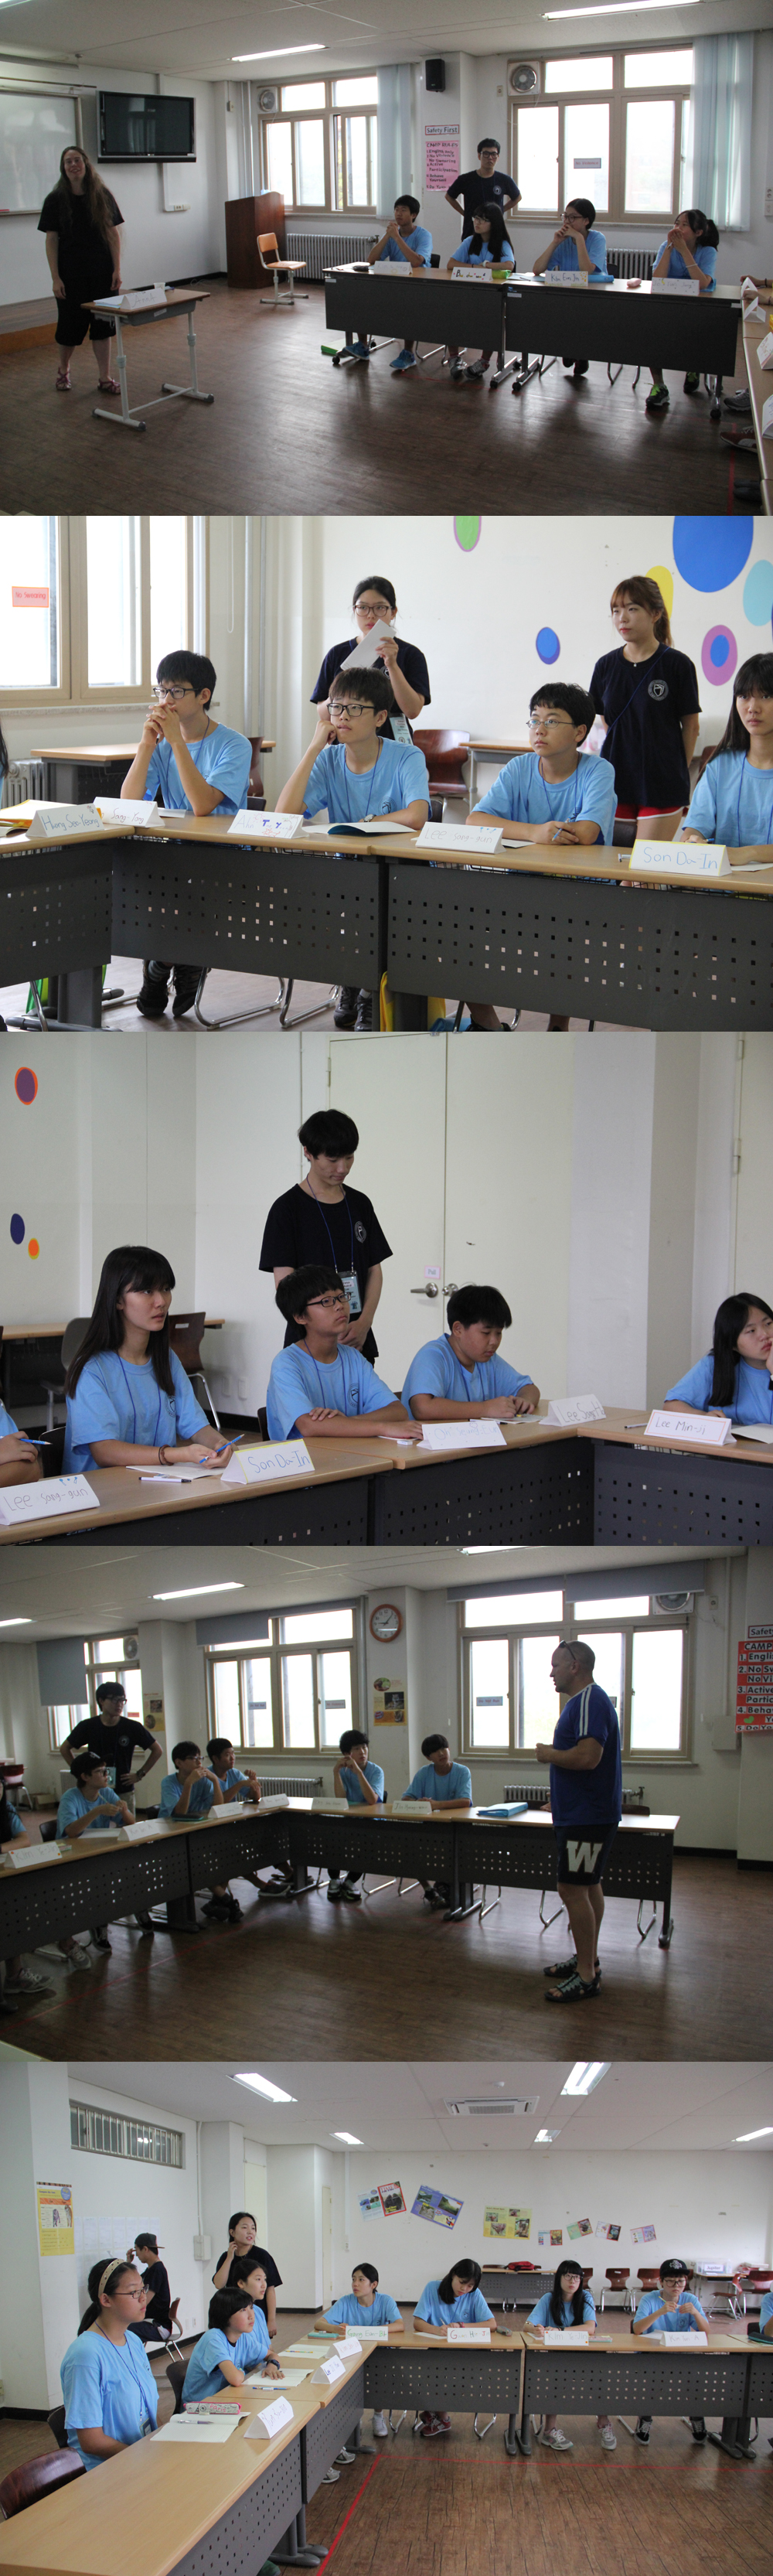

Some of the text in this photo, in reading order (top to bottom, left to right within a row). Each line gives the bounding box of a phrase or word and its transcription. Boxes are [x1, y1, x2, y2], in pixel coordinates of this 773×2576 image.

[550, 273, 561, 282] Kim
[24, 592, 46, 600] Swearing
[233, 814, 254, 829] Ahn
[424, 827, 448, 840] Lee
[643, 846, 717, 869] Son Da-In
[557, 1405, 581, 1423] Lee
[655, 1416, 707, 1435] Lee Min-ji
[434, 1427, 451, 1440] Oh
[247, 1450, 311, 1474] Son Da-In
[3, 1495, 33, 1511] Lee
[567, 1841, 602, 1872] W
[544, 2332, 564, 2341] Kim
